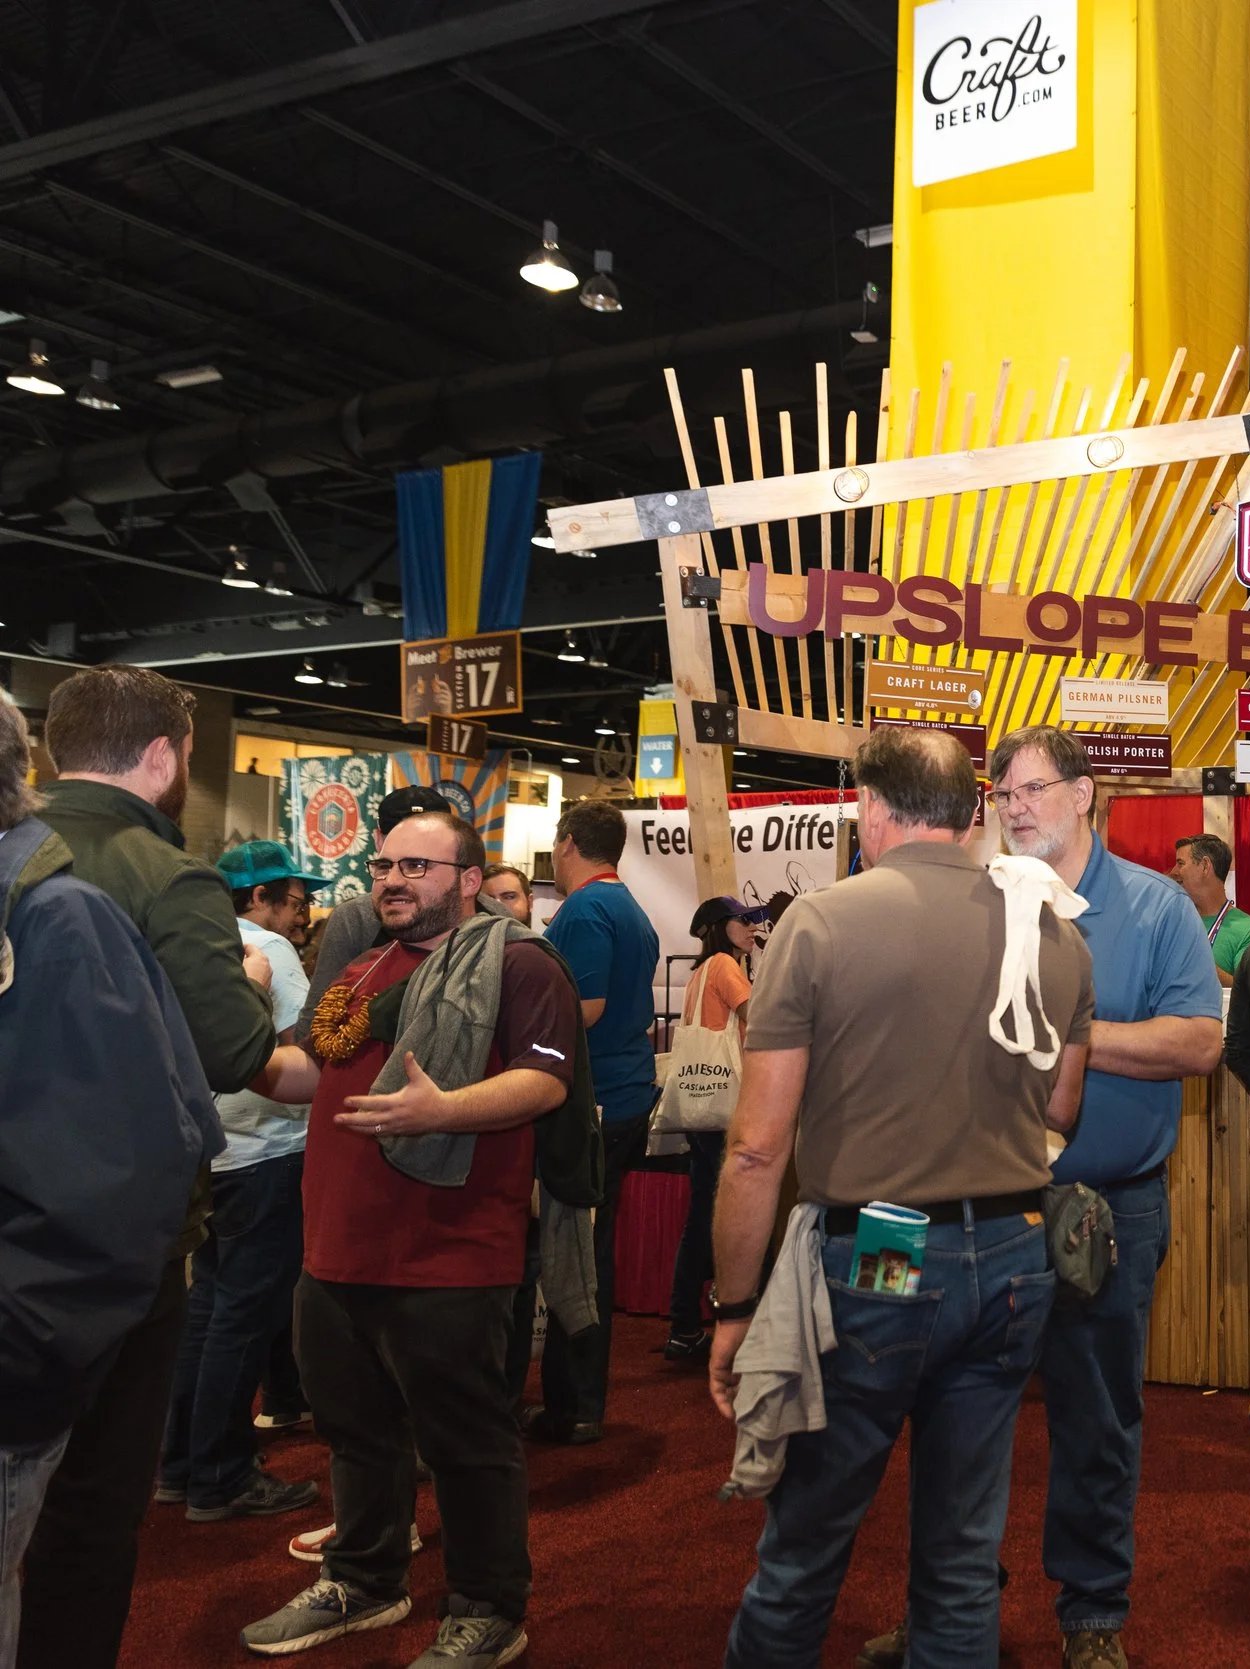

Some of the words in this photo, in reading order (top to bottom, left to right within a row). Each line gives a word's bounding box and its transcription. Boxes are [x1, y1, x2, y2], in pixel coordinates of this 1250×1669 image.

[922, 14, 1066, 122] Craft
[935, 101, 987, 131] BEER
[747, 562, 1199, 667] UPSLOPE
[454, 645, 502, 660] Brewer
[926, 666, 945, 674] SERIES
[465, 661, 501, 708] 17
[887, 676, 925, 689] CRAFT
[930, 680, 967, 693] LAGER
[1068, 691, 1113, 703] GERMAN
[1118, 693, 1162, 705] PILSNER
[450, 722, 474, 754] 17
[642, 740, 674, 751] WATER
[1084, 745, 1119, 756] GLISH
[1124, 747, 1164, 758] PORTER
